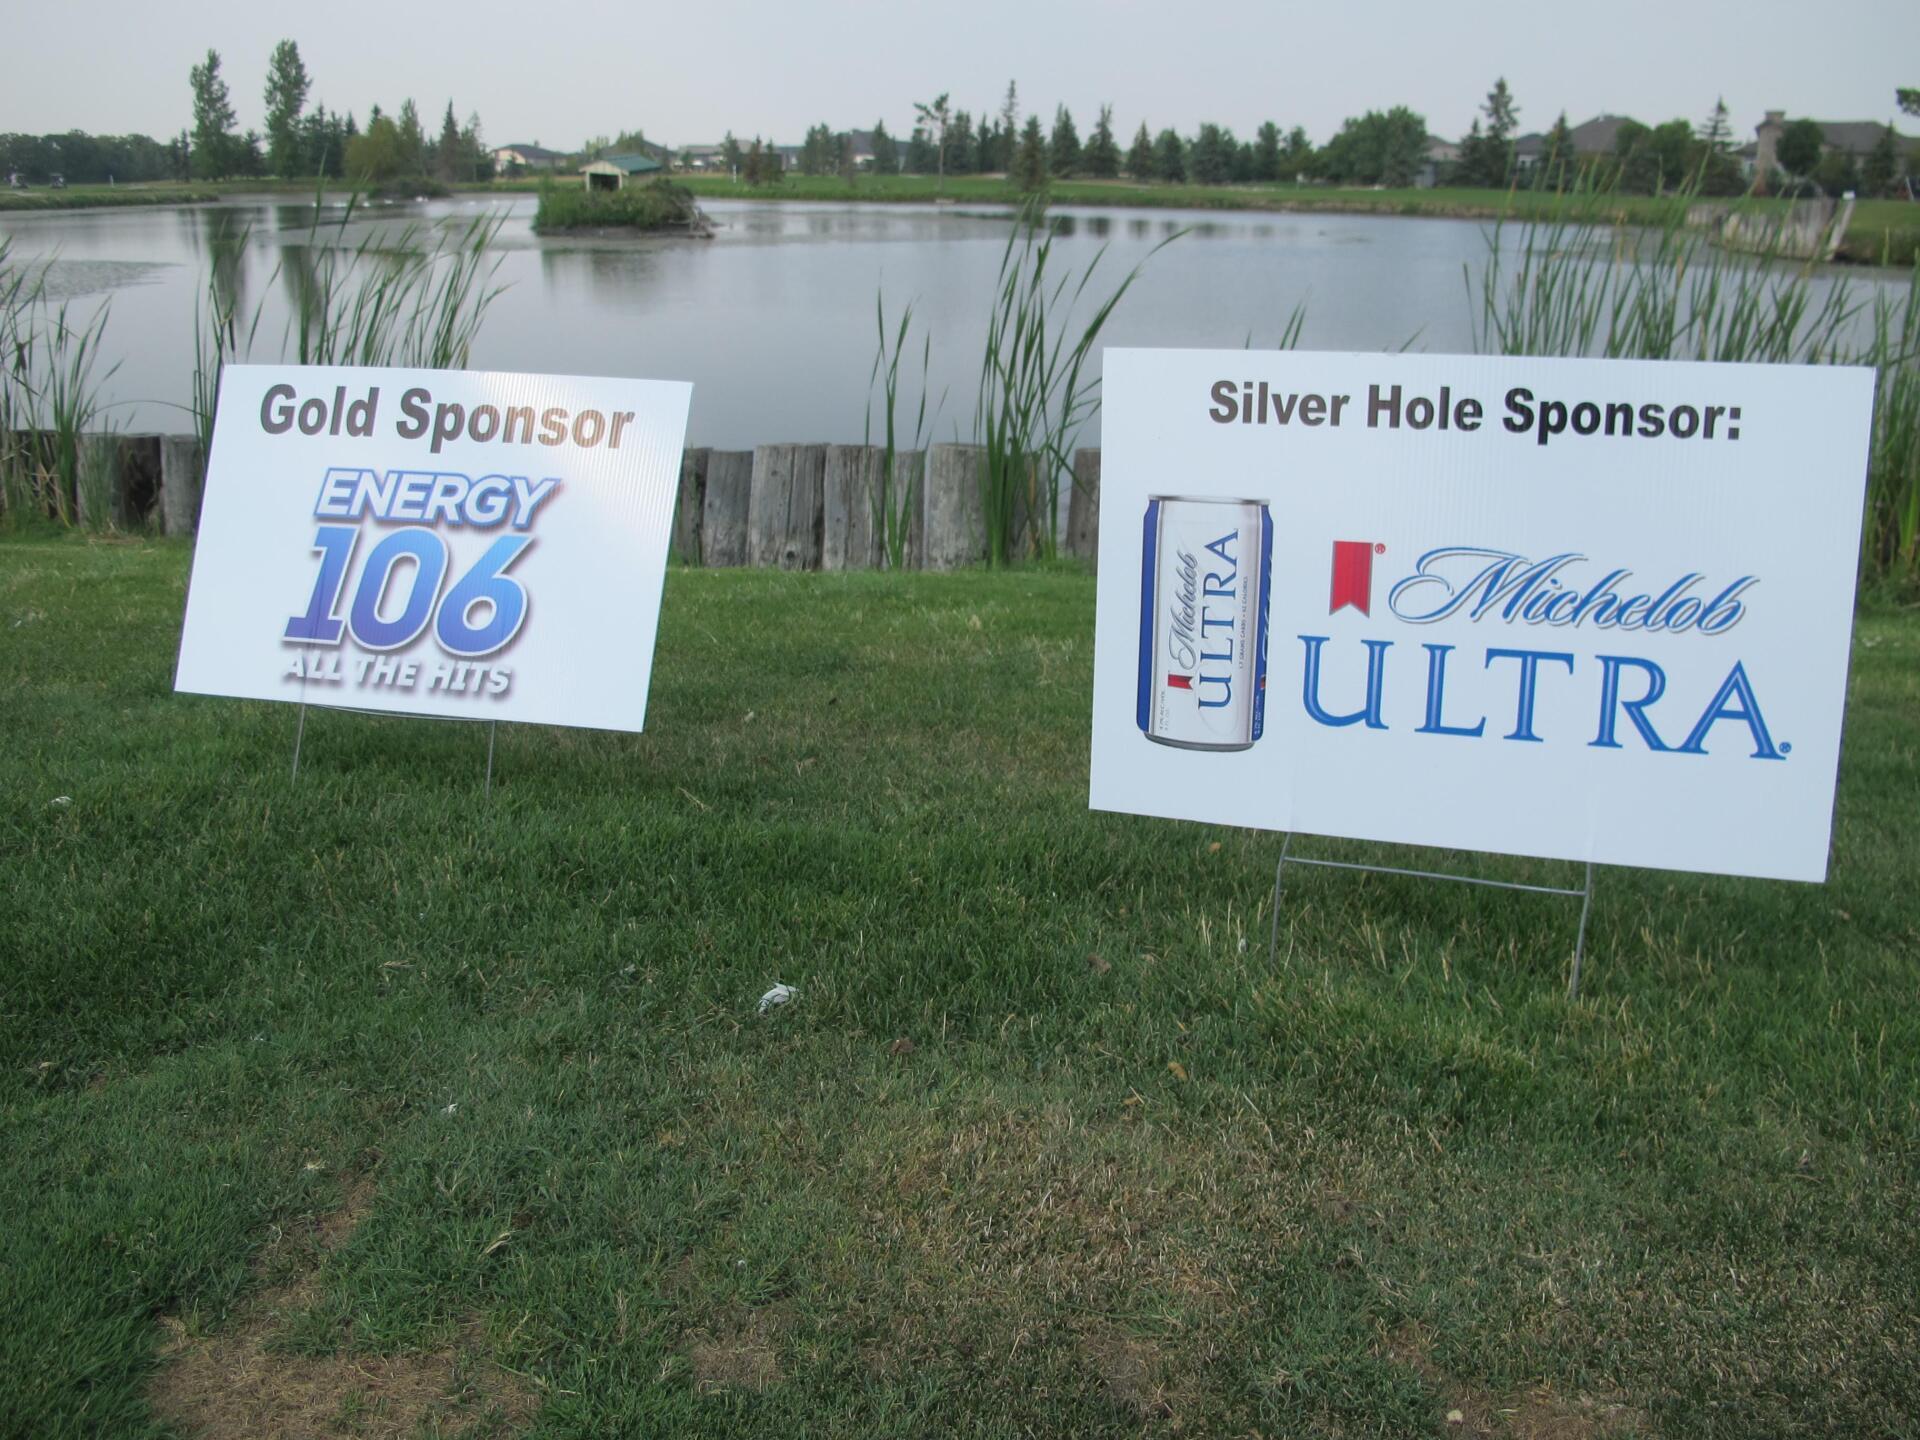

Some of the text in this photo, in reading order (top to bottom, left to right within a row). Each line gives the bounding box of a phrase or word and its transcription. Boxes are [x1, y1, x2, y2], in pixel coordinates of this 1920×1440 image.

[260, 384, 635, 454] Gold Sponsor
[1209, 380, 1742, 446] Silver Hole Sponsor:
[314, 467, 561, 529] ENERGY
[283, 523, 535, 658] 106
[1169, 549, 1198, 670] Michelob
[1198, 530, 1239, 710] ULTRA
[1389, 546, 1760, 637] Michelob
[285, 653, 512, 695] ALL THE HITS
[1297, 635, 1787, 760] ULTRA
